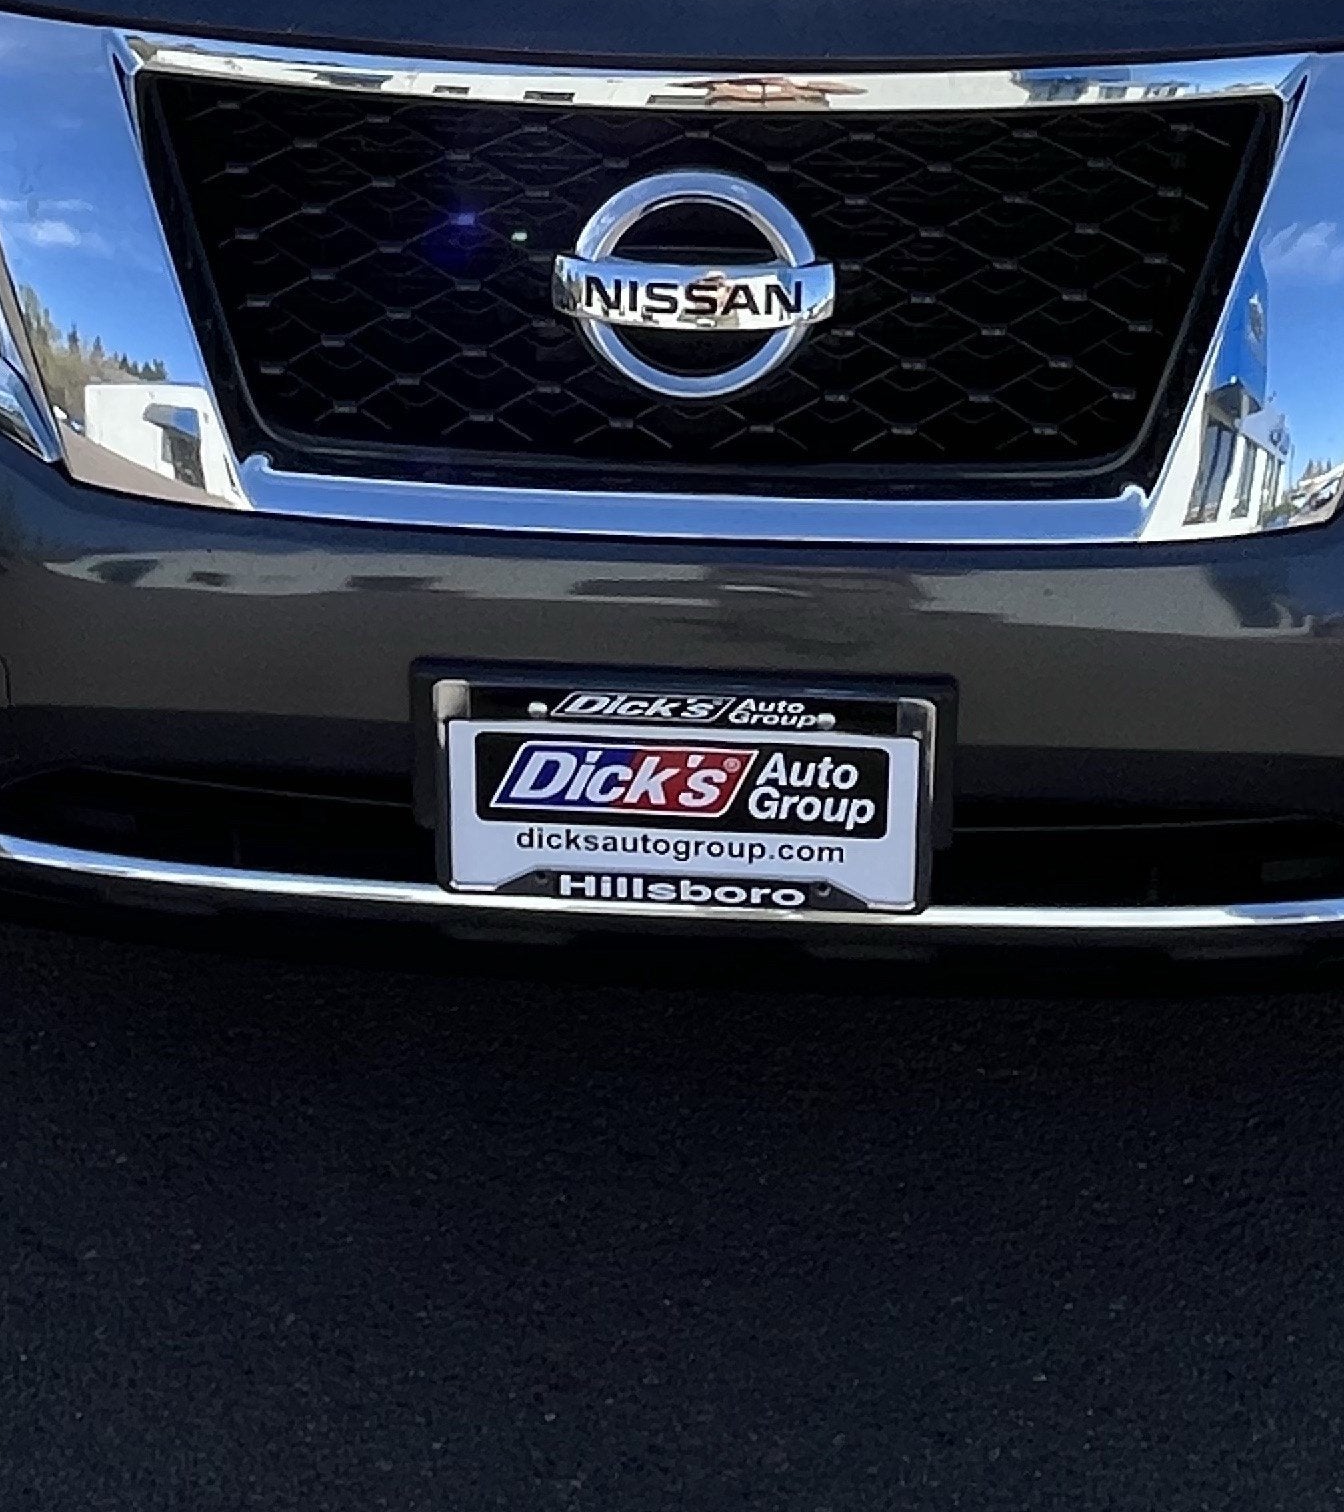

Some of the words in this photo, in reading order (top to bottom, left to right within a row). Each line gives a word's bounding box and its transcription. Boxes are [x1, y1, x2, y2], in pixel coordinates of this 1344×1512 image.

[584, 276, 802, 317] NISSAN
[564, 694, 715, 719] Dick's
[728, 711, 817, 728] Group
[736, 698, 806, 714] Auto
[508, 750, 729, 807] Dick's
[756, 752, 858, 788] Auto
[748, 787, 875, 830] Group
[516, 827, 845, 863] dicksautogroup.com
[559, 874, 806, 907] Hillsboro
